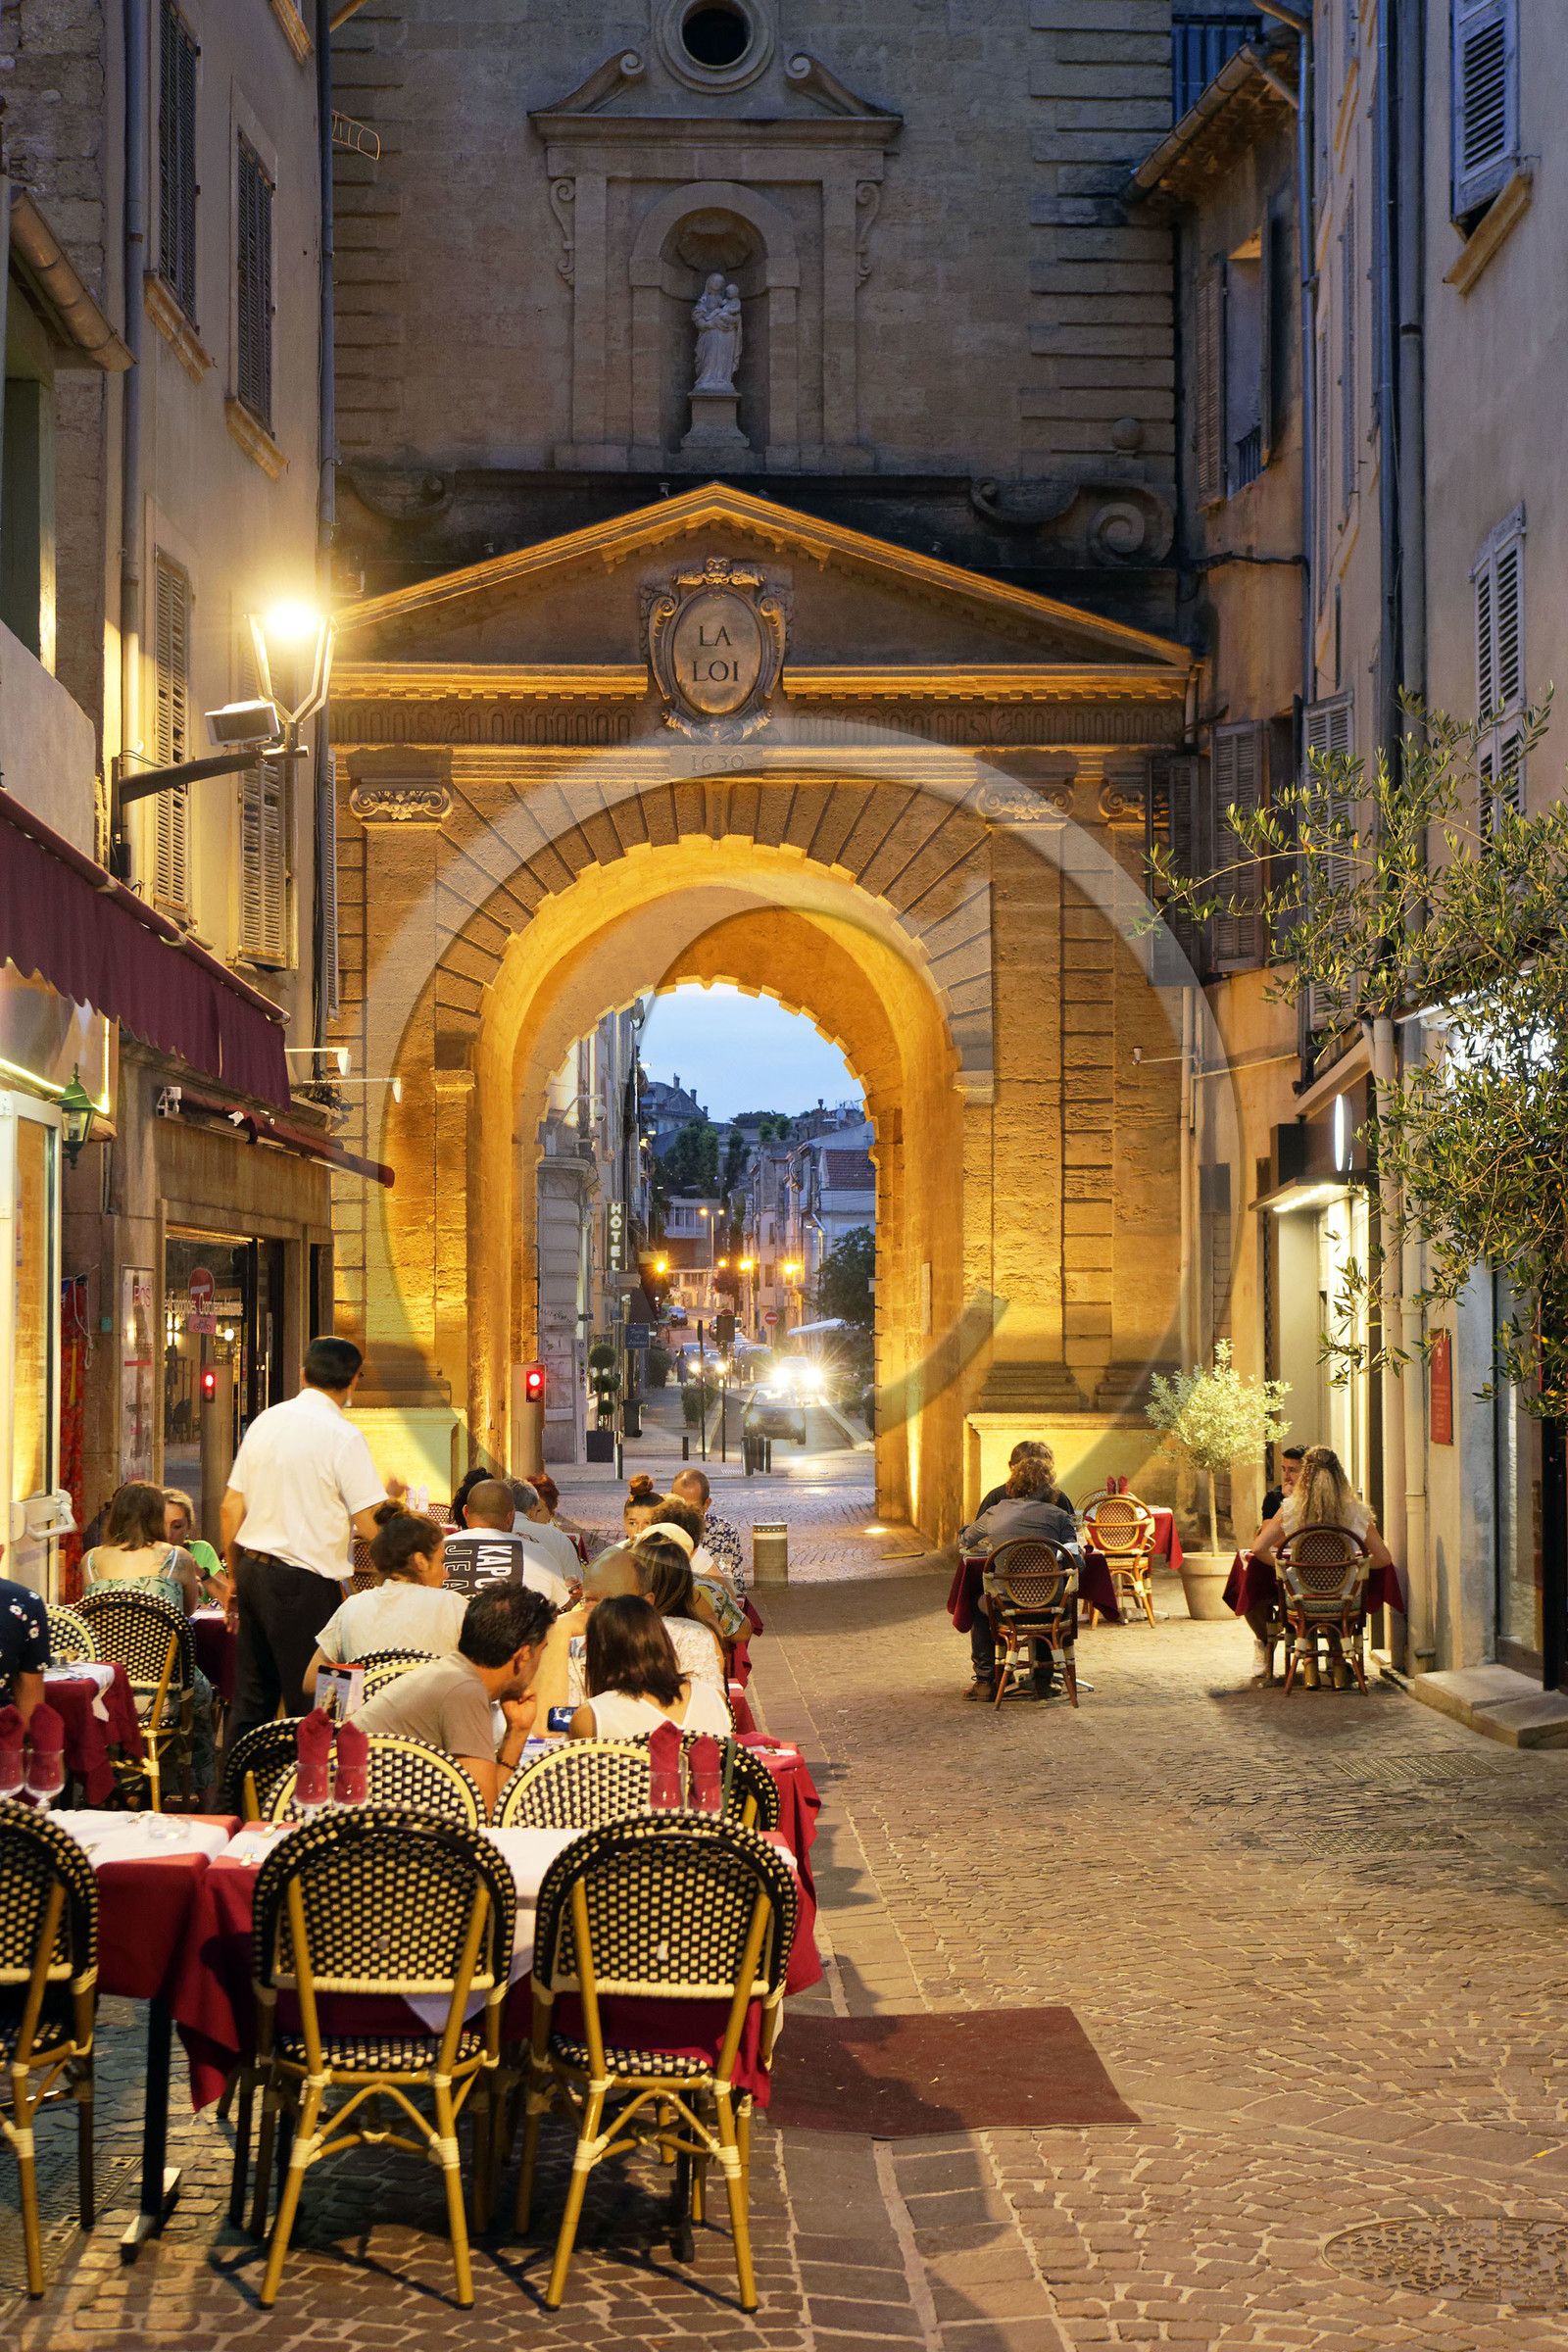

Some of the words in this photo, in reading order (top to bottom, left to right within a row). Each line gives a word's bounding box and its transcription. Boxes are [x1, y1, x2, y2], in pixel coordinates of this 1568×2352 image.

[699, 625, 732, 647] LA
[693, 660, 739, 682] LOI
[691, 754, 745, 772] 1630
[442, 1544, 476, 1598] JEA
[474, 1544, 513, 1595] KAPO
